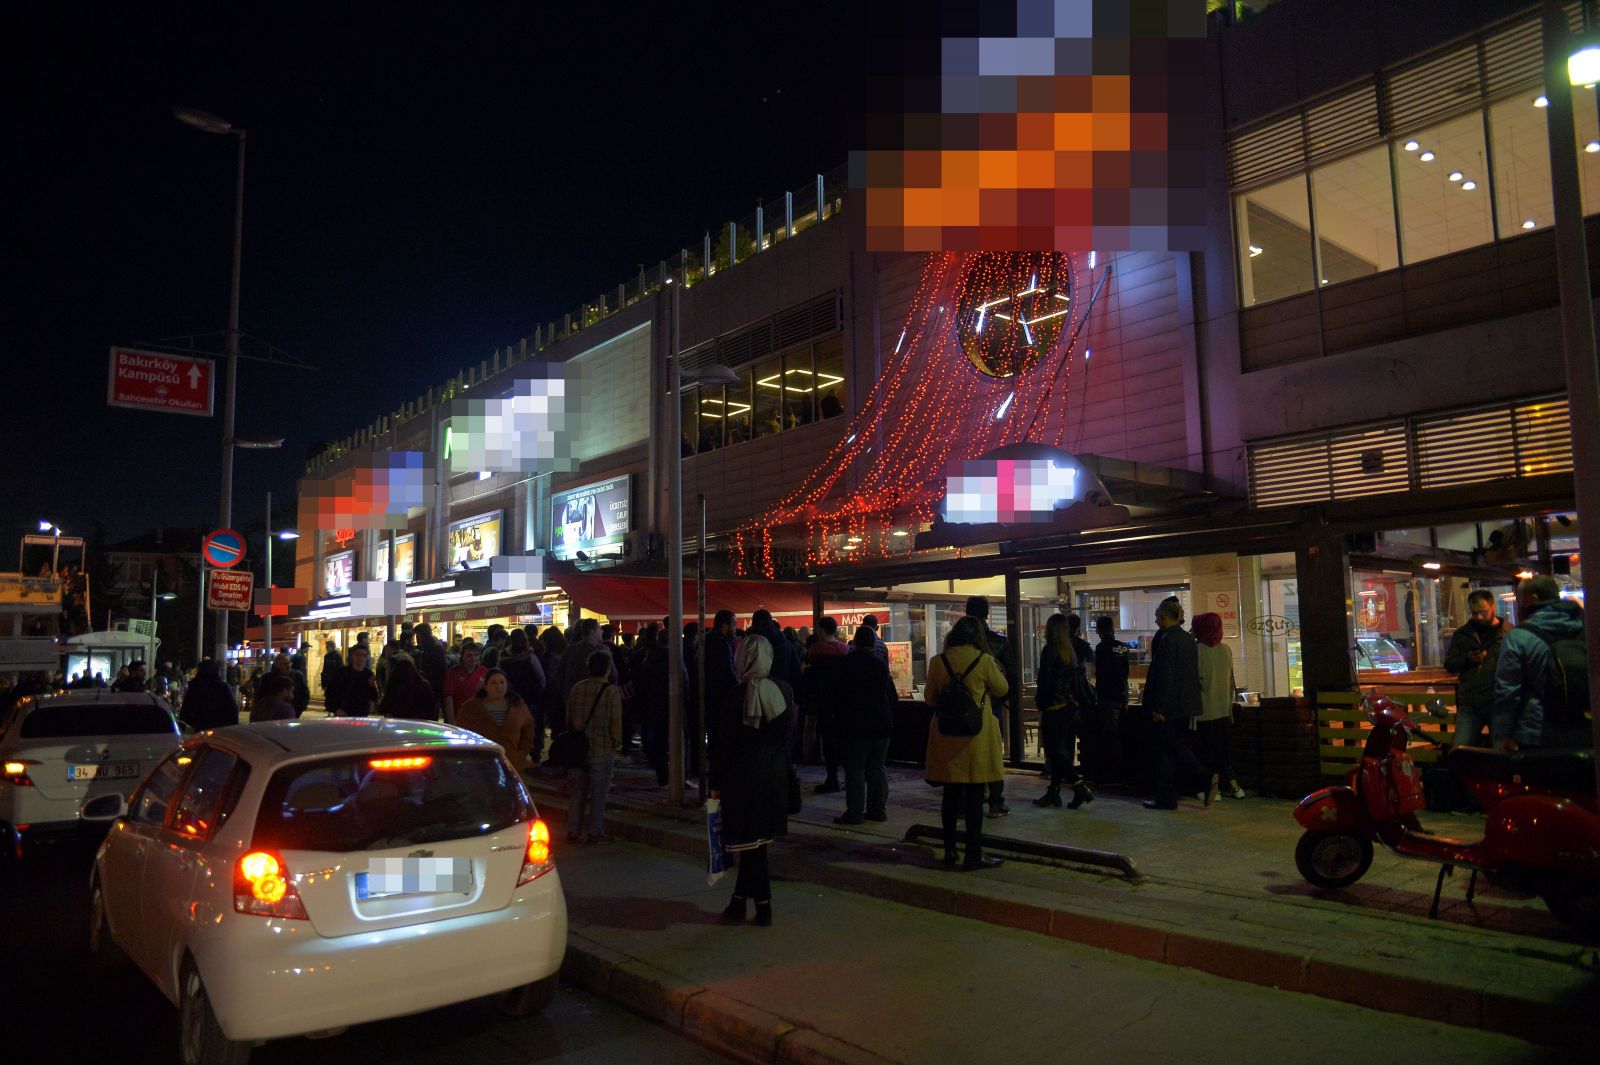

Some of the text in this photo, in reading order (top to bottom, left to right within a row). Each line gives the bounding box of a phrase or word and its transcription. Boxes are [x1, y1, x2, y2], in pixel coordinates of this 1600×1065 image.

[119, 354, 178, 373] Bakırköy
[118, 367, 180, 384] Kampüsü
[229, 583, 241, 591] EDS
[76, 767, 88, 778] 34
